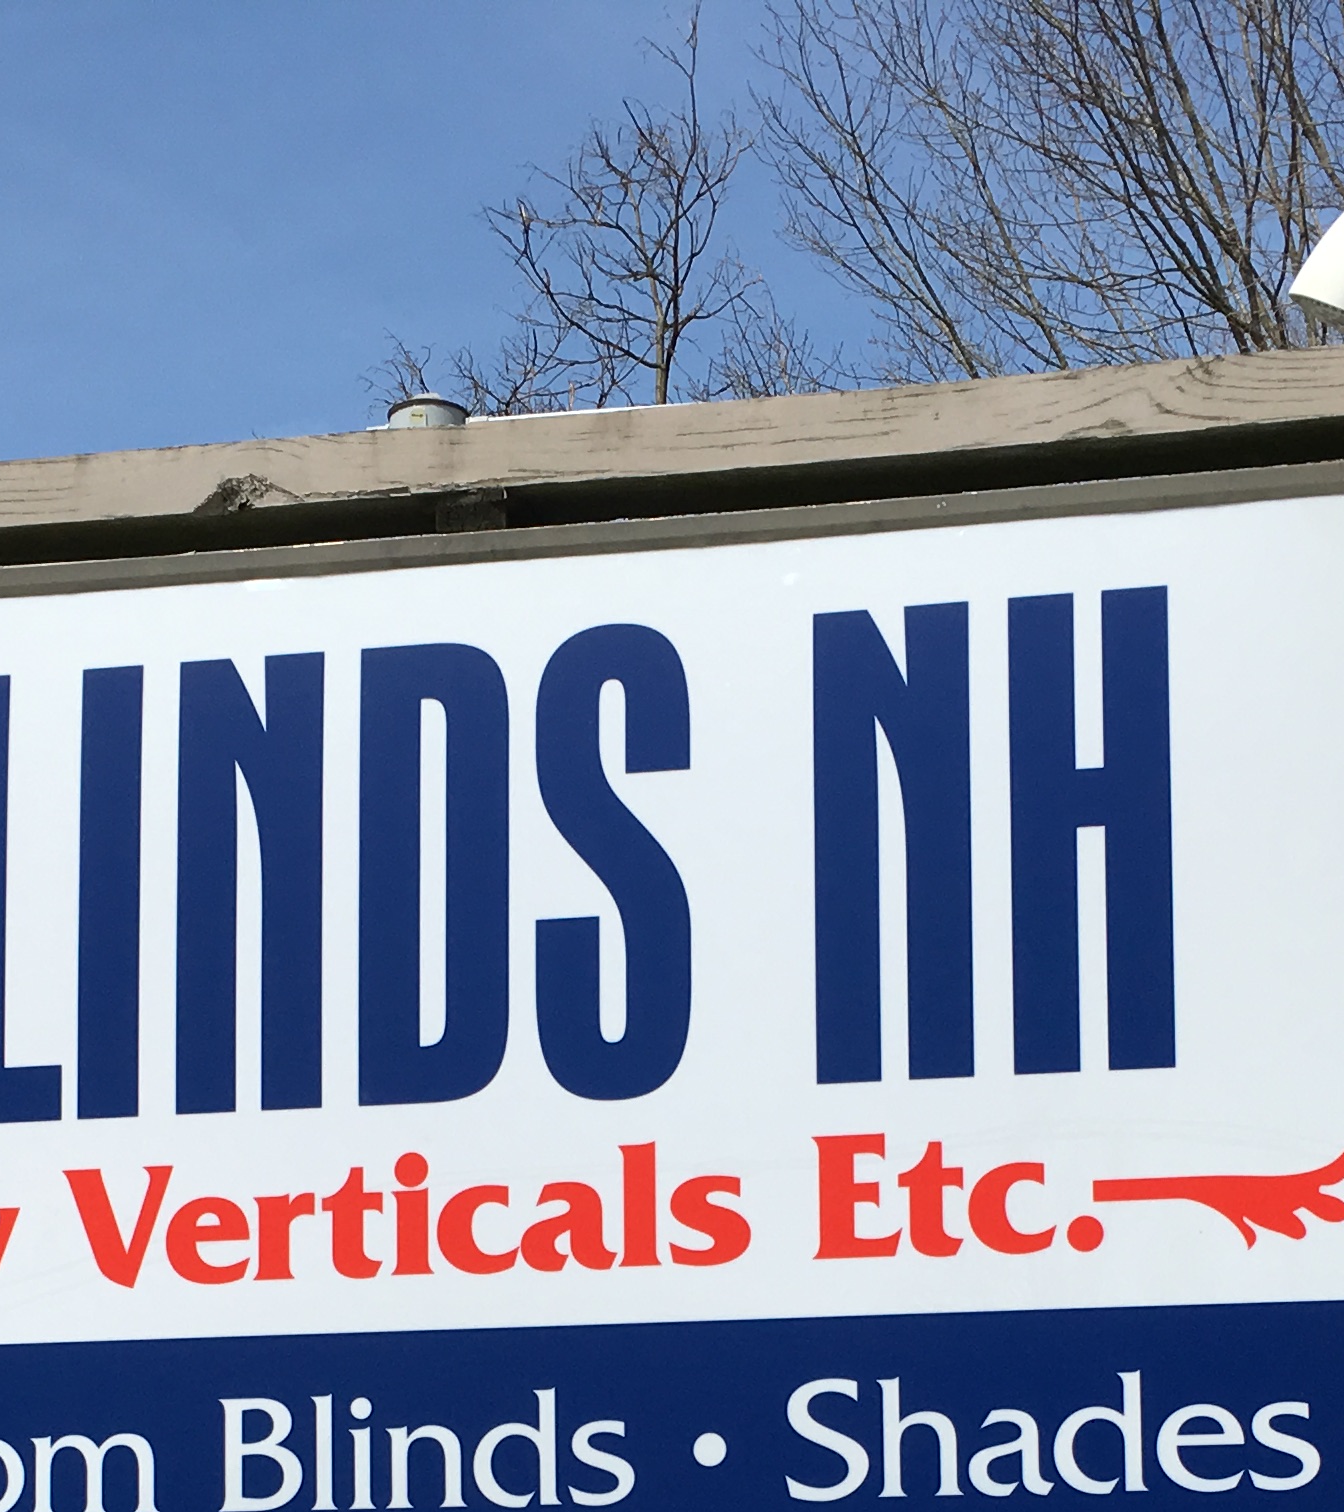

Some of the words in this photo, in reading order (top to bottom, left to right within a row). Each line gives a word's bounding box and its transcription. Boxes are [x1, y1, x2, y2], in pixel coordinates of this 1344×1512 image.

[812, 585, 1176, 1085] NH
[63, 1141, 752, 1289] Verticals
[812, 1132, 1106, 1260] Etc.
[218, 1387, 635, 1512] Blinds
[785, 1369, 1321, 1502] Shades
